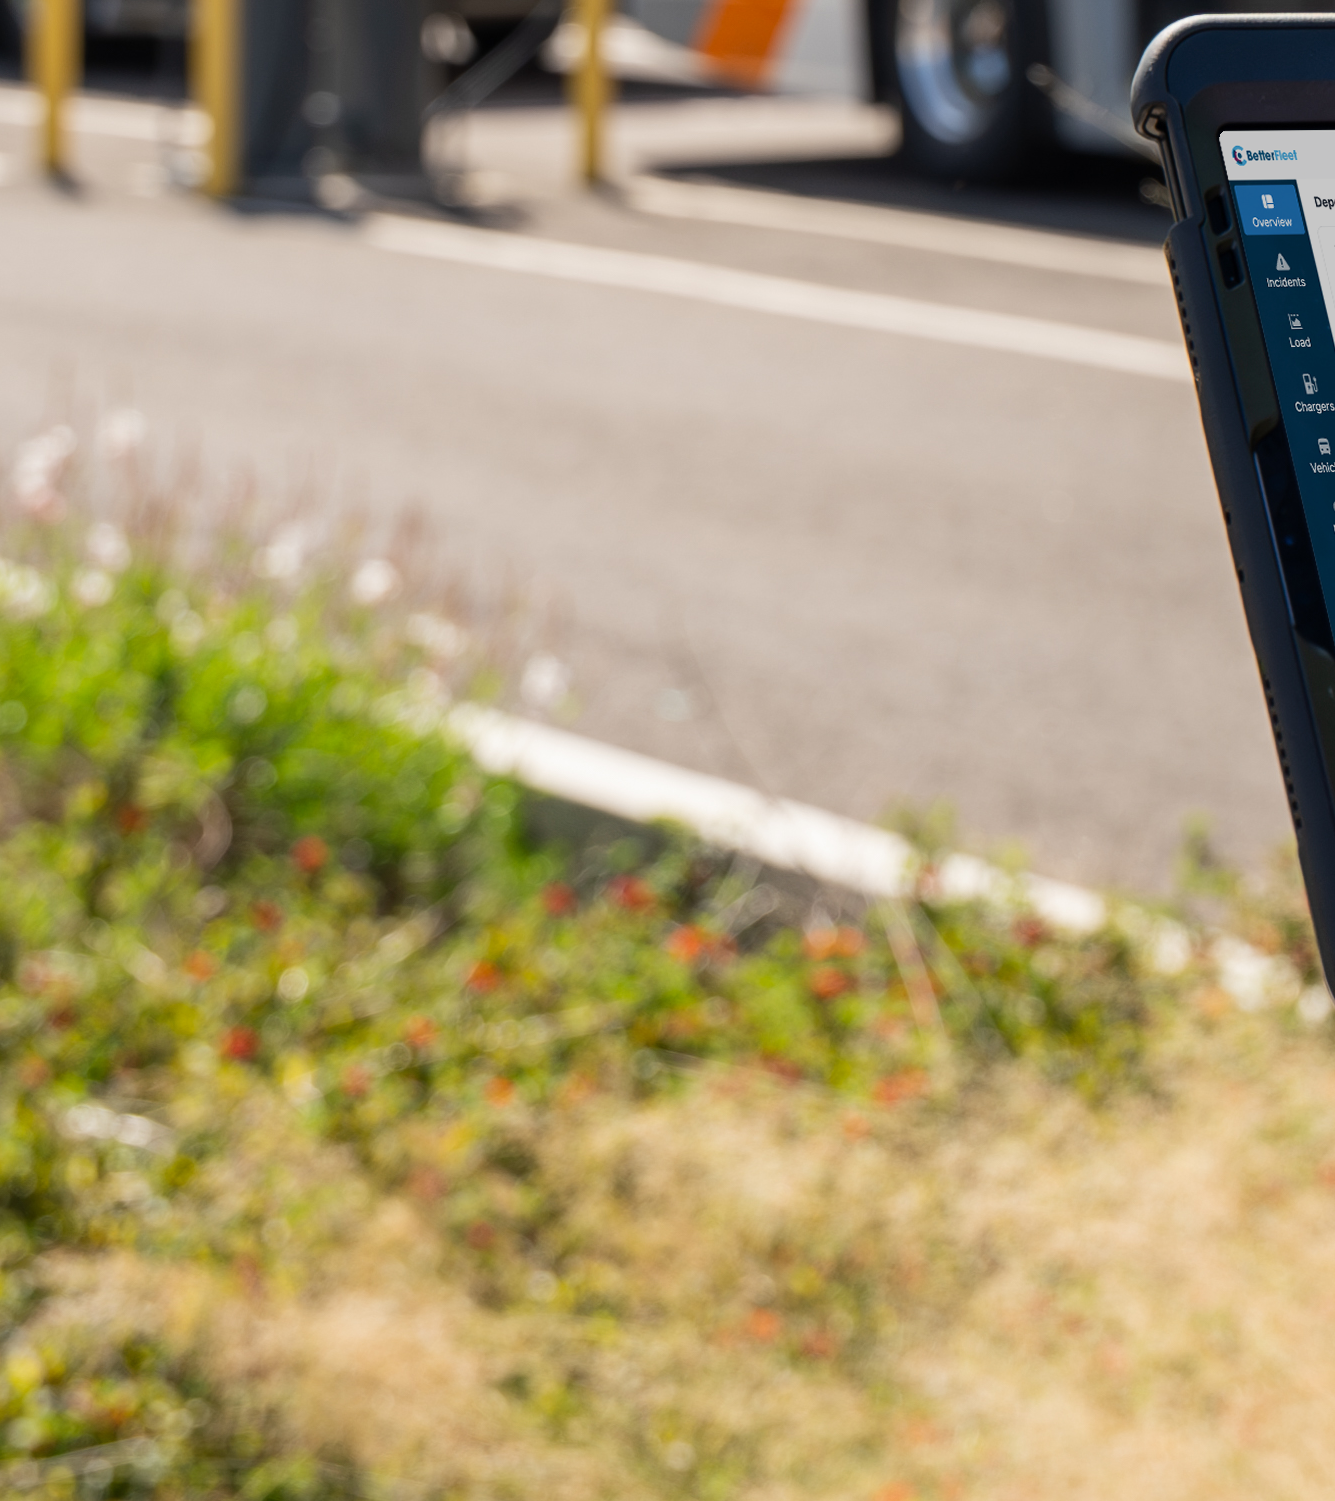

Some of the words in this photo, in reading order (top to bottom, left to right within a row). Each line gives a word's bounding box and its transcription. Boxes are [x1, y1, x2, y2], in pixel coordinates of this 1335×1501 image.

[1246, 149, 1298, 163] BetterFleet
[1252, 216, 1293, 228] Overview
[1266, 276, 1307, 288] Incidents
[1288, 336, 1312, 348] Load
[1294, 401, 1335, 415] Chargers
